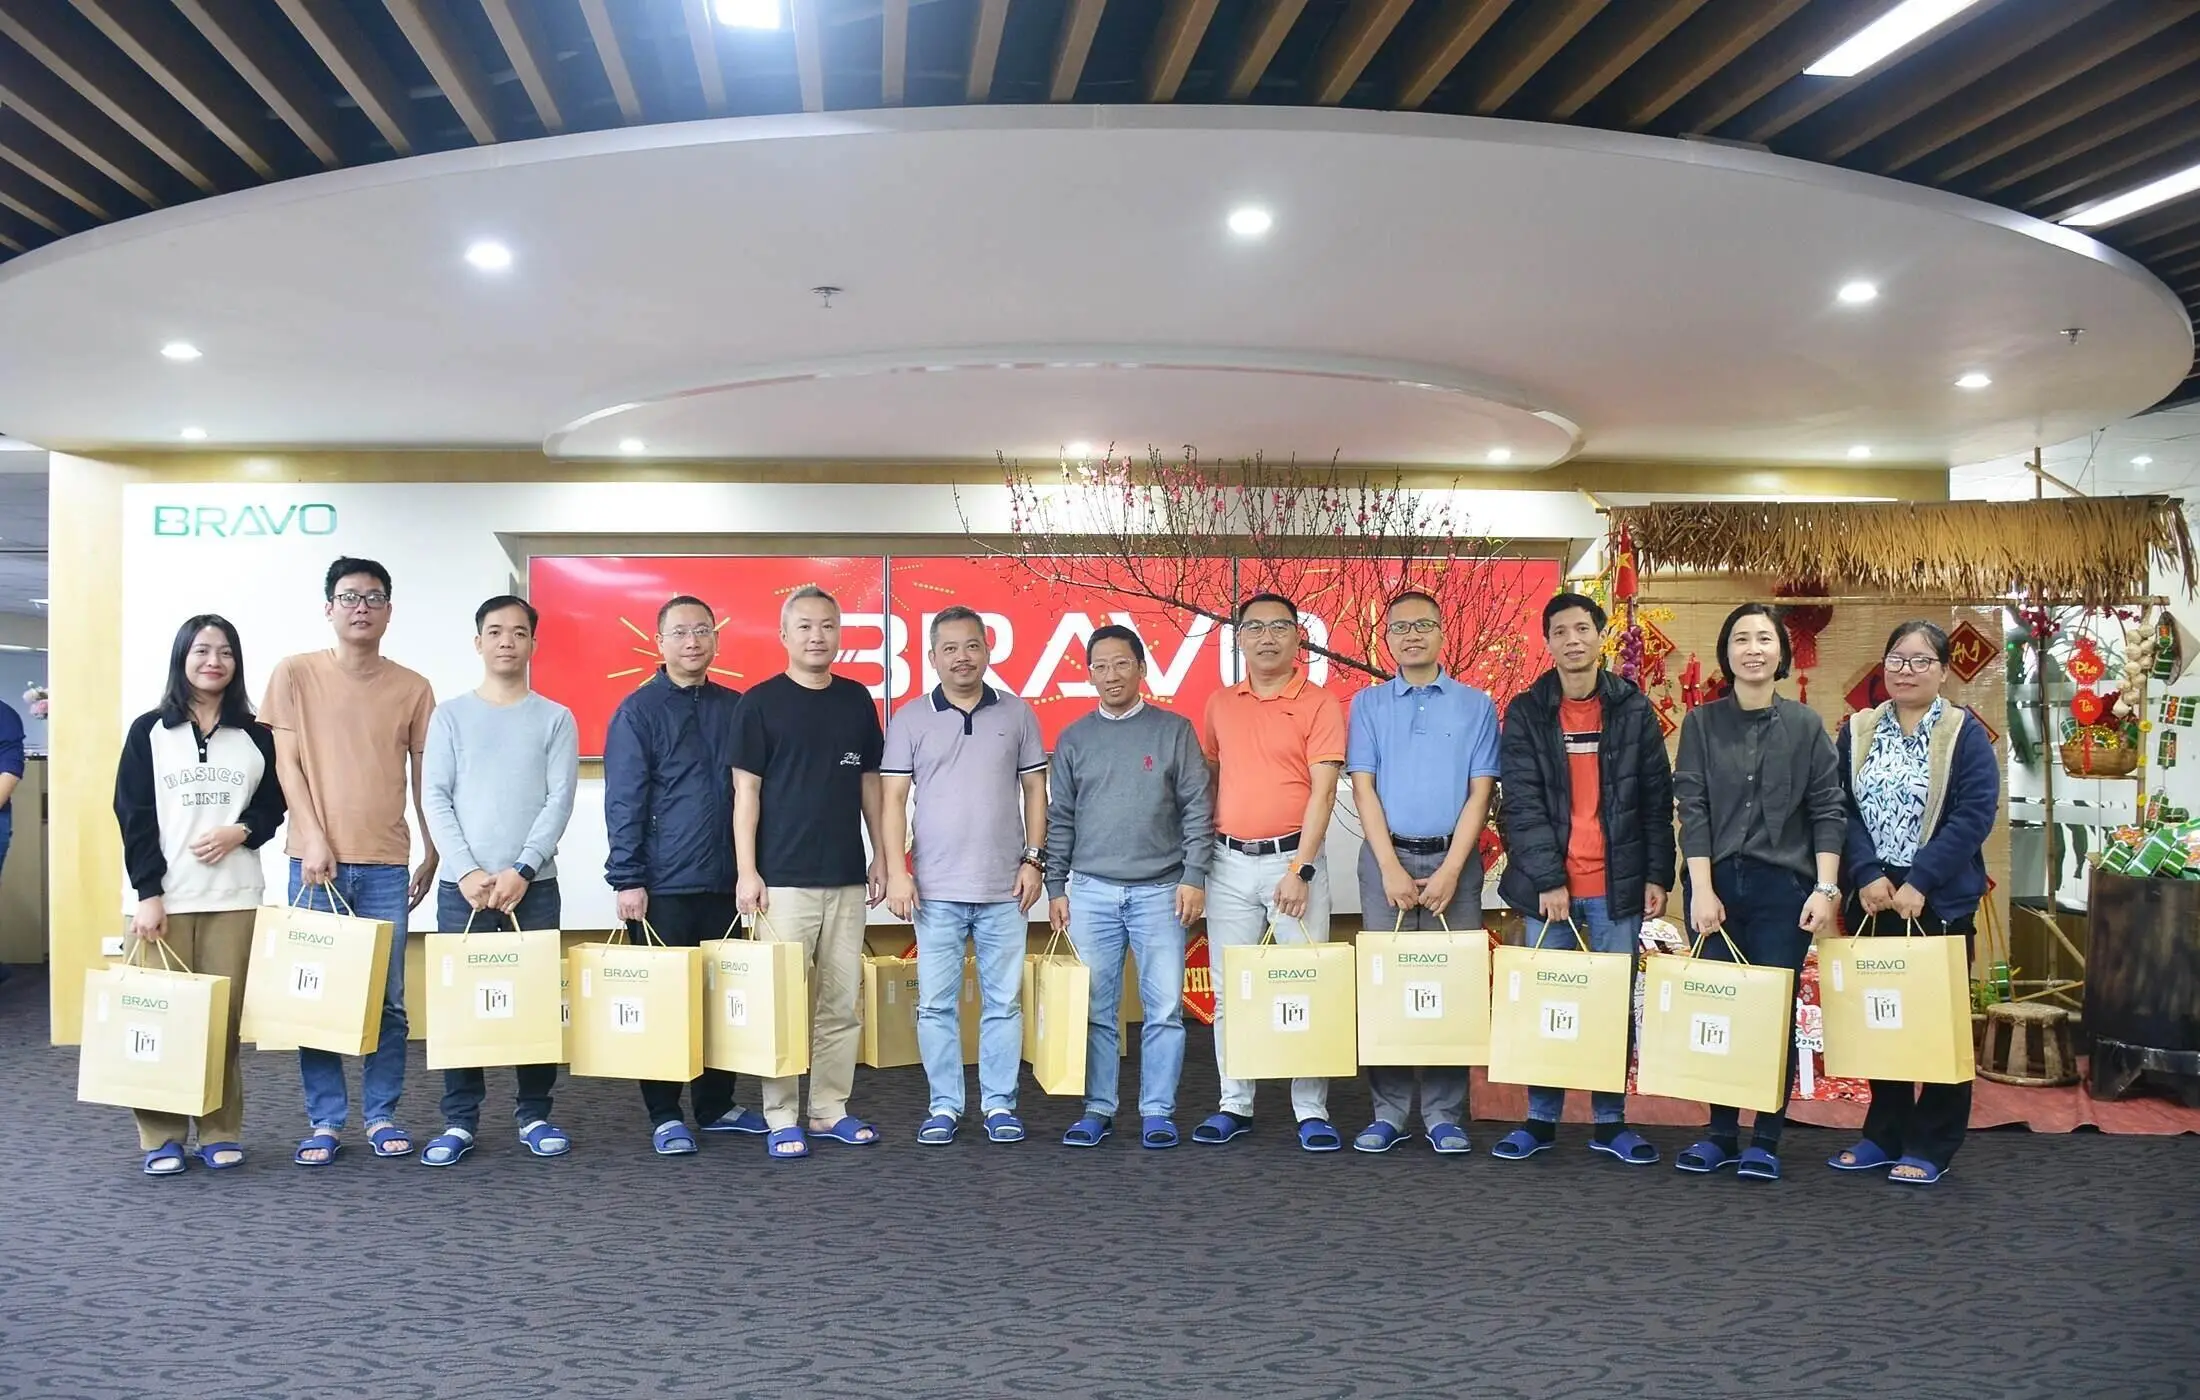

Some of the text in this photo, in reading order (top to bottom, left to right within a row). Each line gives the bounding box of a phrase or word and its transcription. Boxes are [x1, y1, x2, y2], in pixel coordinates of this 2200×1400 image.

[154, 503, 338, 537] BRAVO
[163, 767, 246, 790] BASICS
[182, 792, 231, 807] LINE
[288, 931, 333, 945] BRAVO
[468, 953, 518, 963] BRAVO
[1398, 953, 1447, 963] BRAVO
[1856, 959, 1905, 970] BRAVO
[604, 968, 649, 978] BRAVO
[721, 961, 748, 972] BRAVO
[1268, 968, 1317, 979] BRAVO
[1537, 971, 1588, 984] BRAVO
[1684, 981, 1736, 996] BRAVO
[121, 995, 168, 1009] BRAVO
